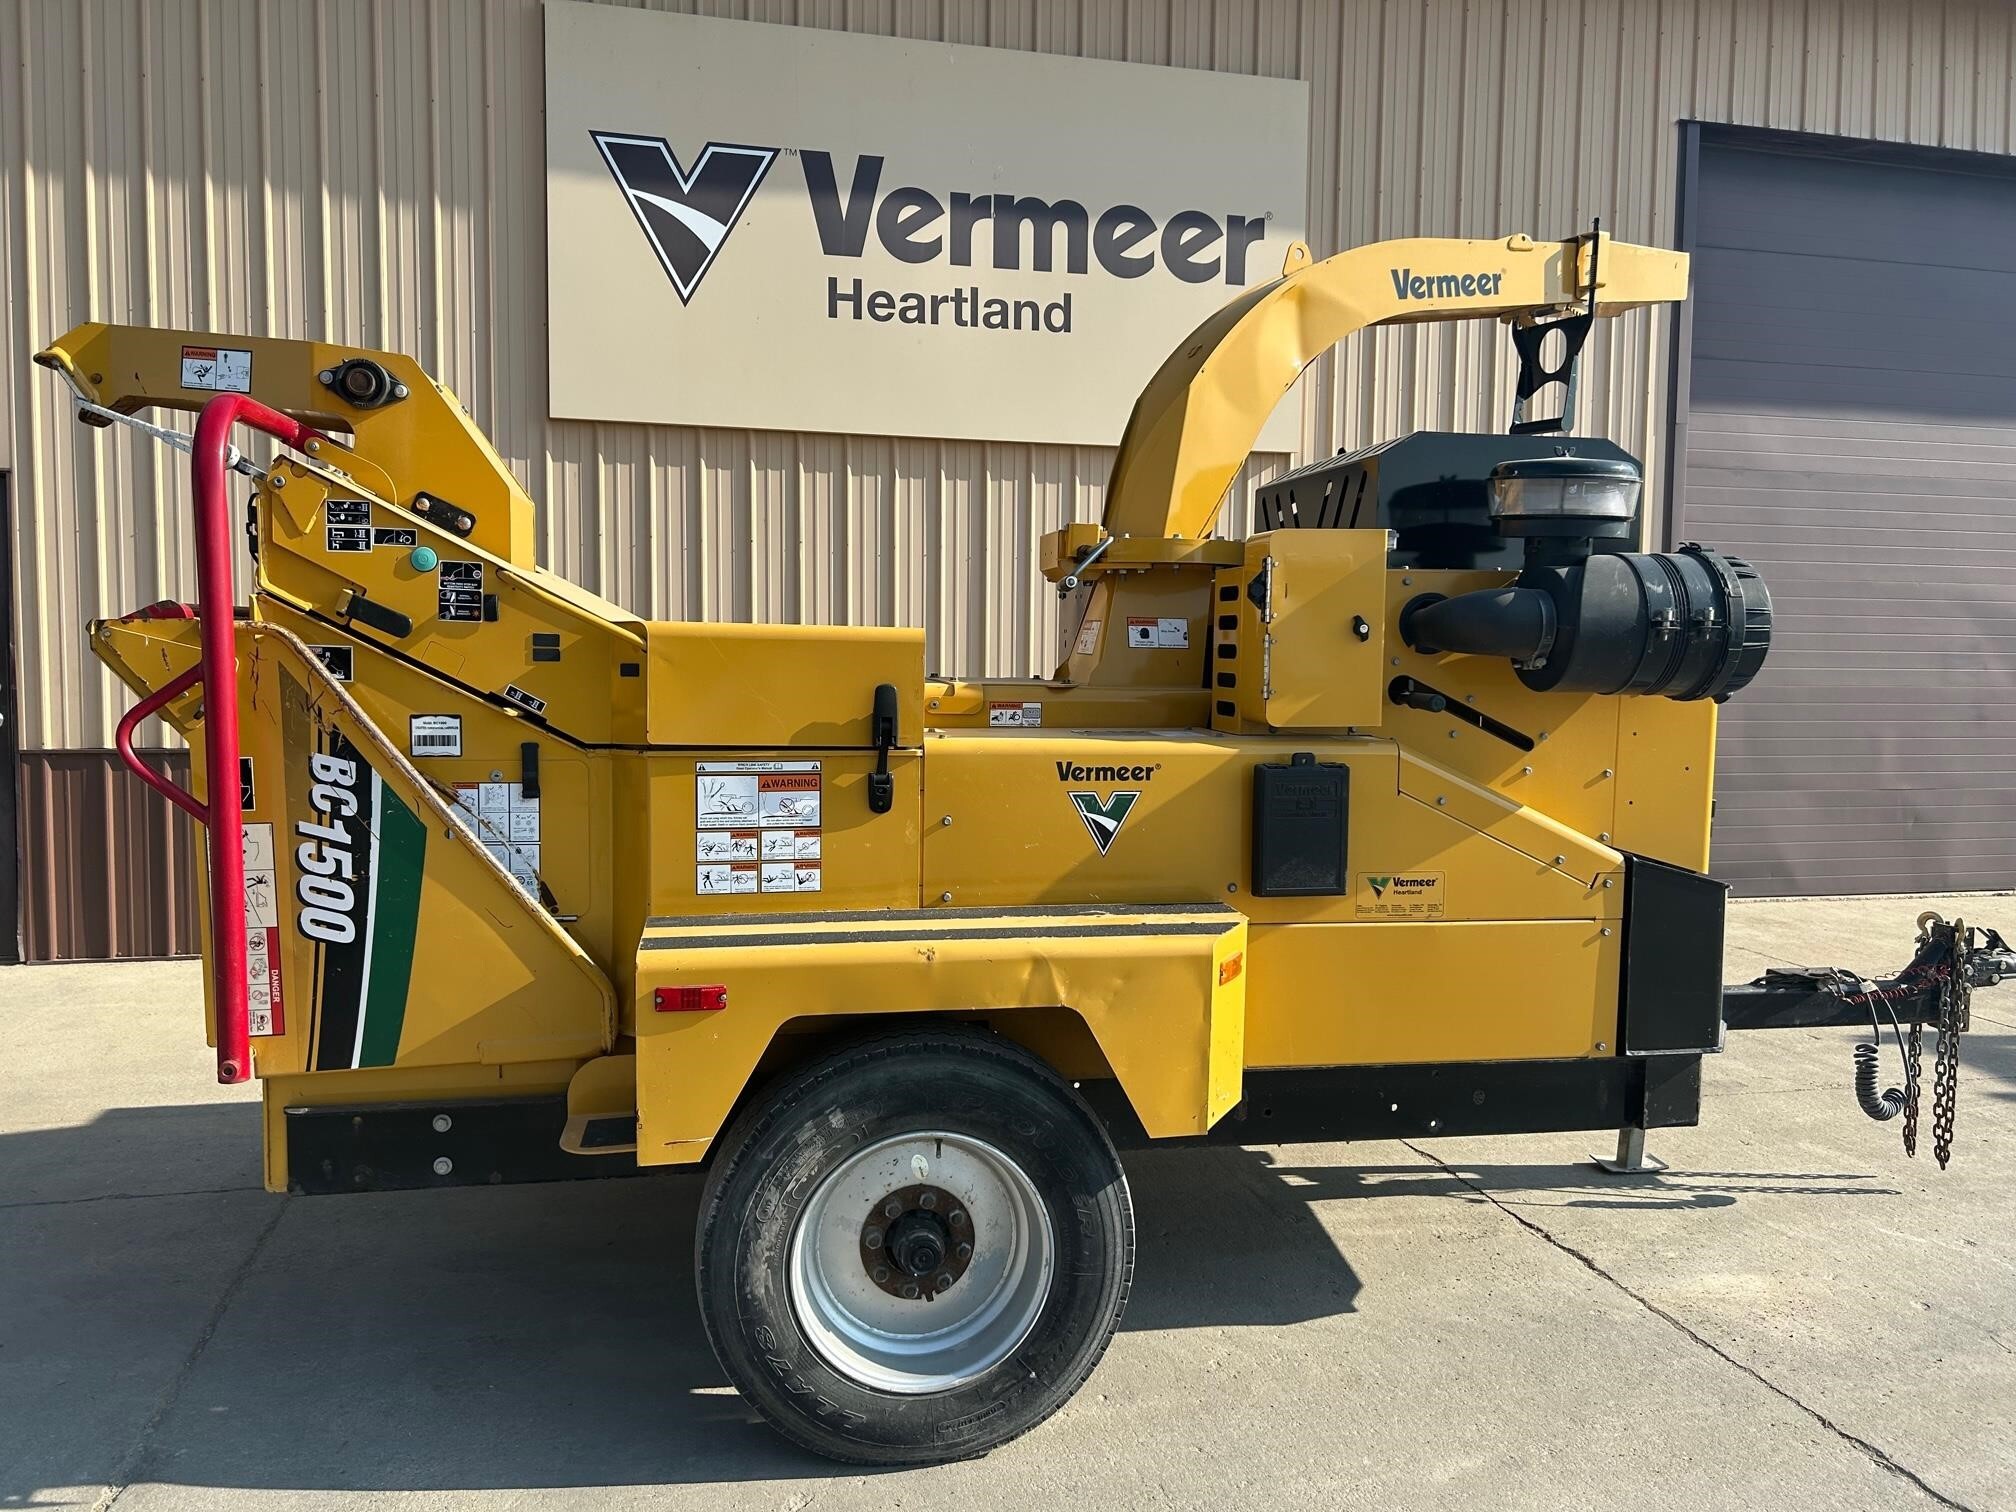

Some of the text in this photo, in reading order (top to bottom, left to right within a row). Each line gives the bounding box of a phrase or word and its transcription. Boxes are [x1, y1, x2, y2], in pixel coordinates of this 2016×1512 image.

[799, 149, 1265, 286] Vermeer
[1391, 268, 1502, 300] Vermeer
[827, 276, 1072, 333] Heartland
[772, 778, 818, 788] WARNING
[1056, 761, 1155, 782] Vermeer
[298, 752, 358, 944] BC1500
[1393, 877, 1437, 887] Vermeer
[271, 969, 280, 1003] DANGER
